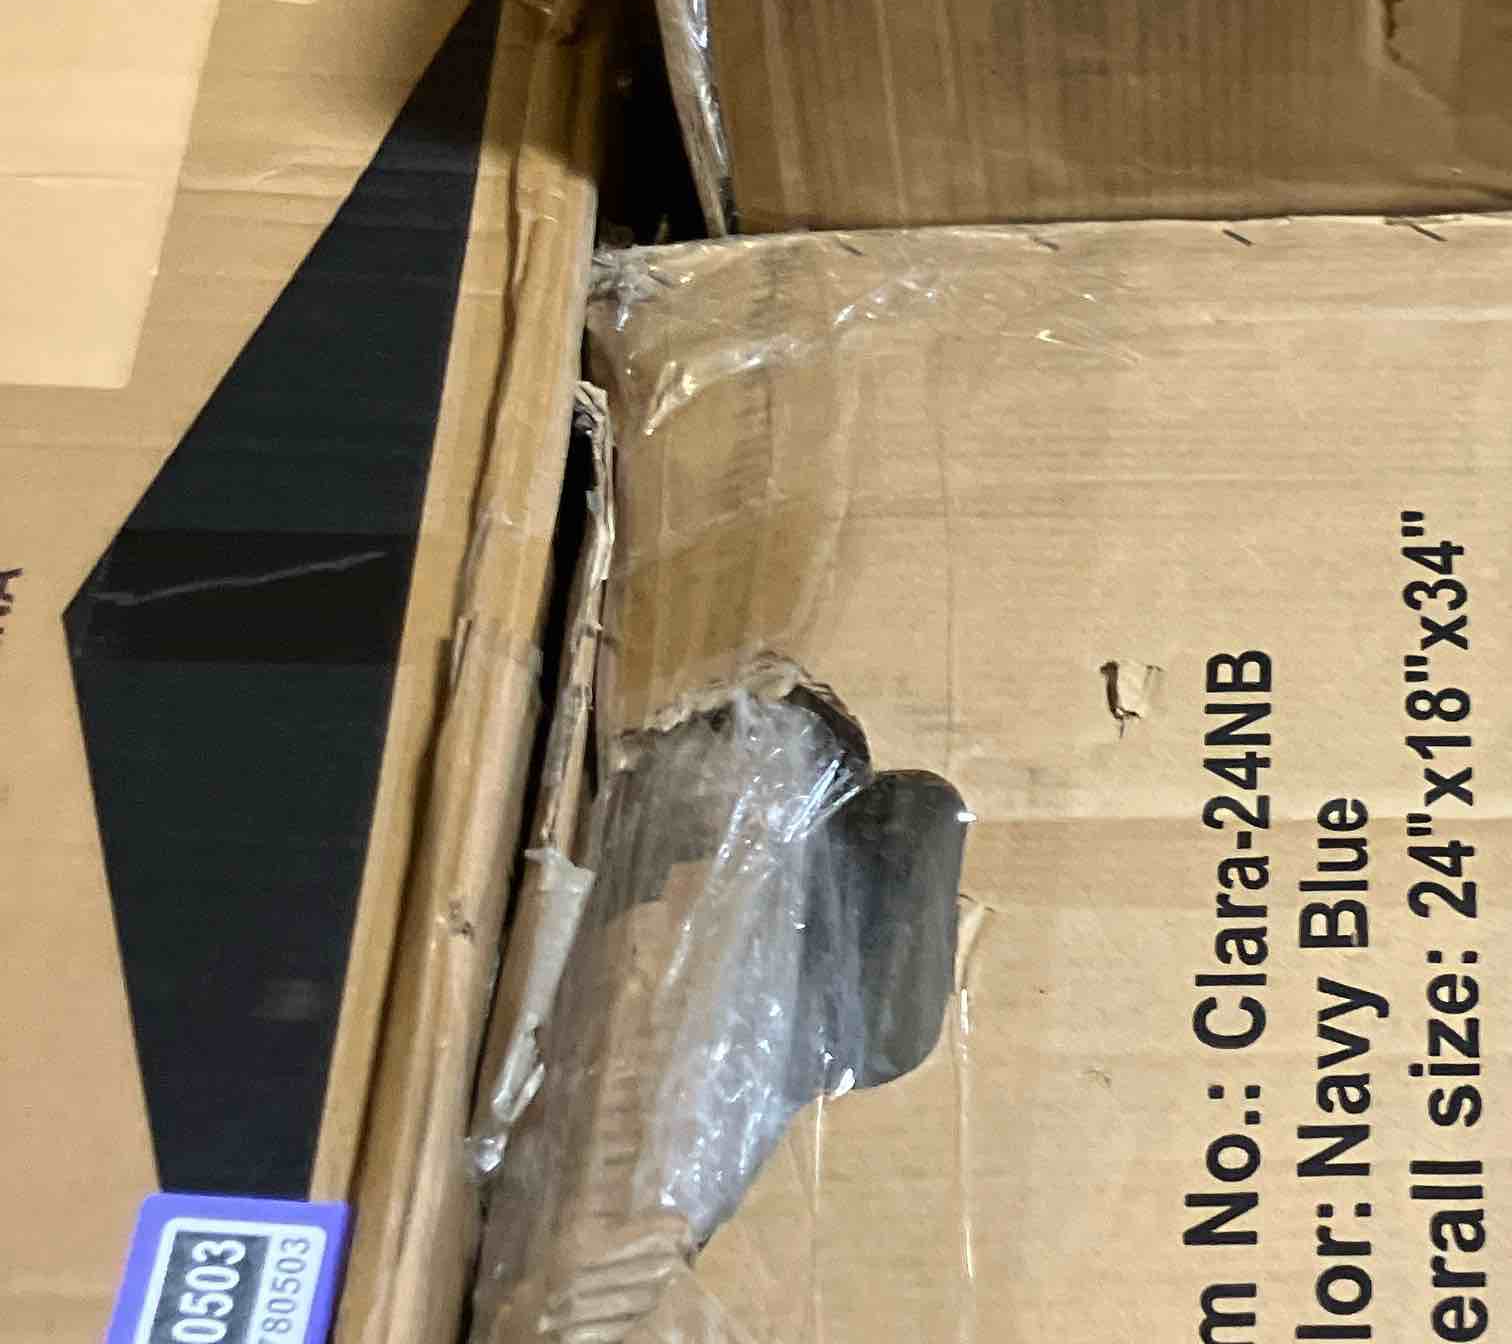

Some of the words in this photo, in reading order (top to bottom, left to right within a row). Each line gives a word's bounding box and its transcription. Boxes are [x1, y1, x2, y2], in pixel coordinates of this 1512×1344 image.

[1192, 649, 1272, 1049] Clara-24NB
[1299, 797, 1369, 949] Blue
[1297, 976, 1390, 1177] Navy
[1408, 950, 1483, 1127] size:
[1182, 1084, 1261, 1246] No.:
[171, 1239, 247, 1344] 0503
